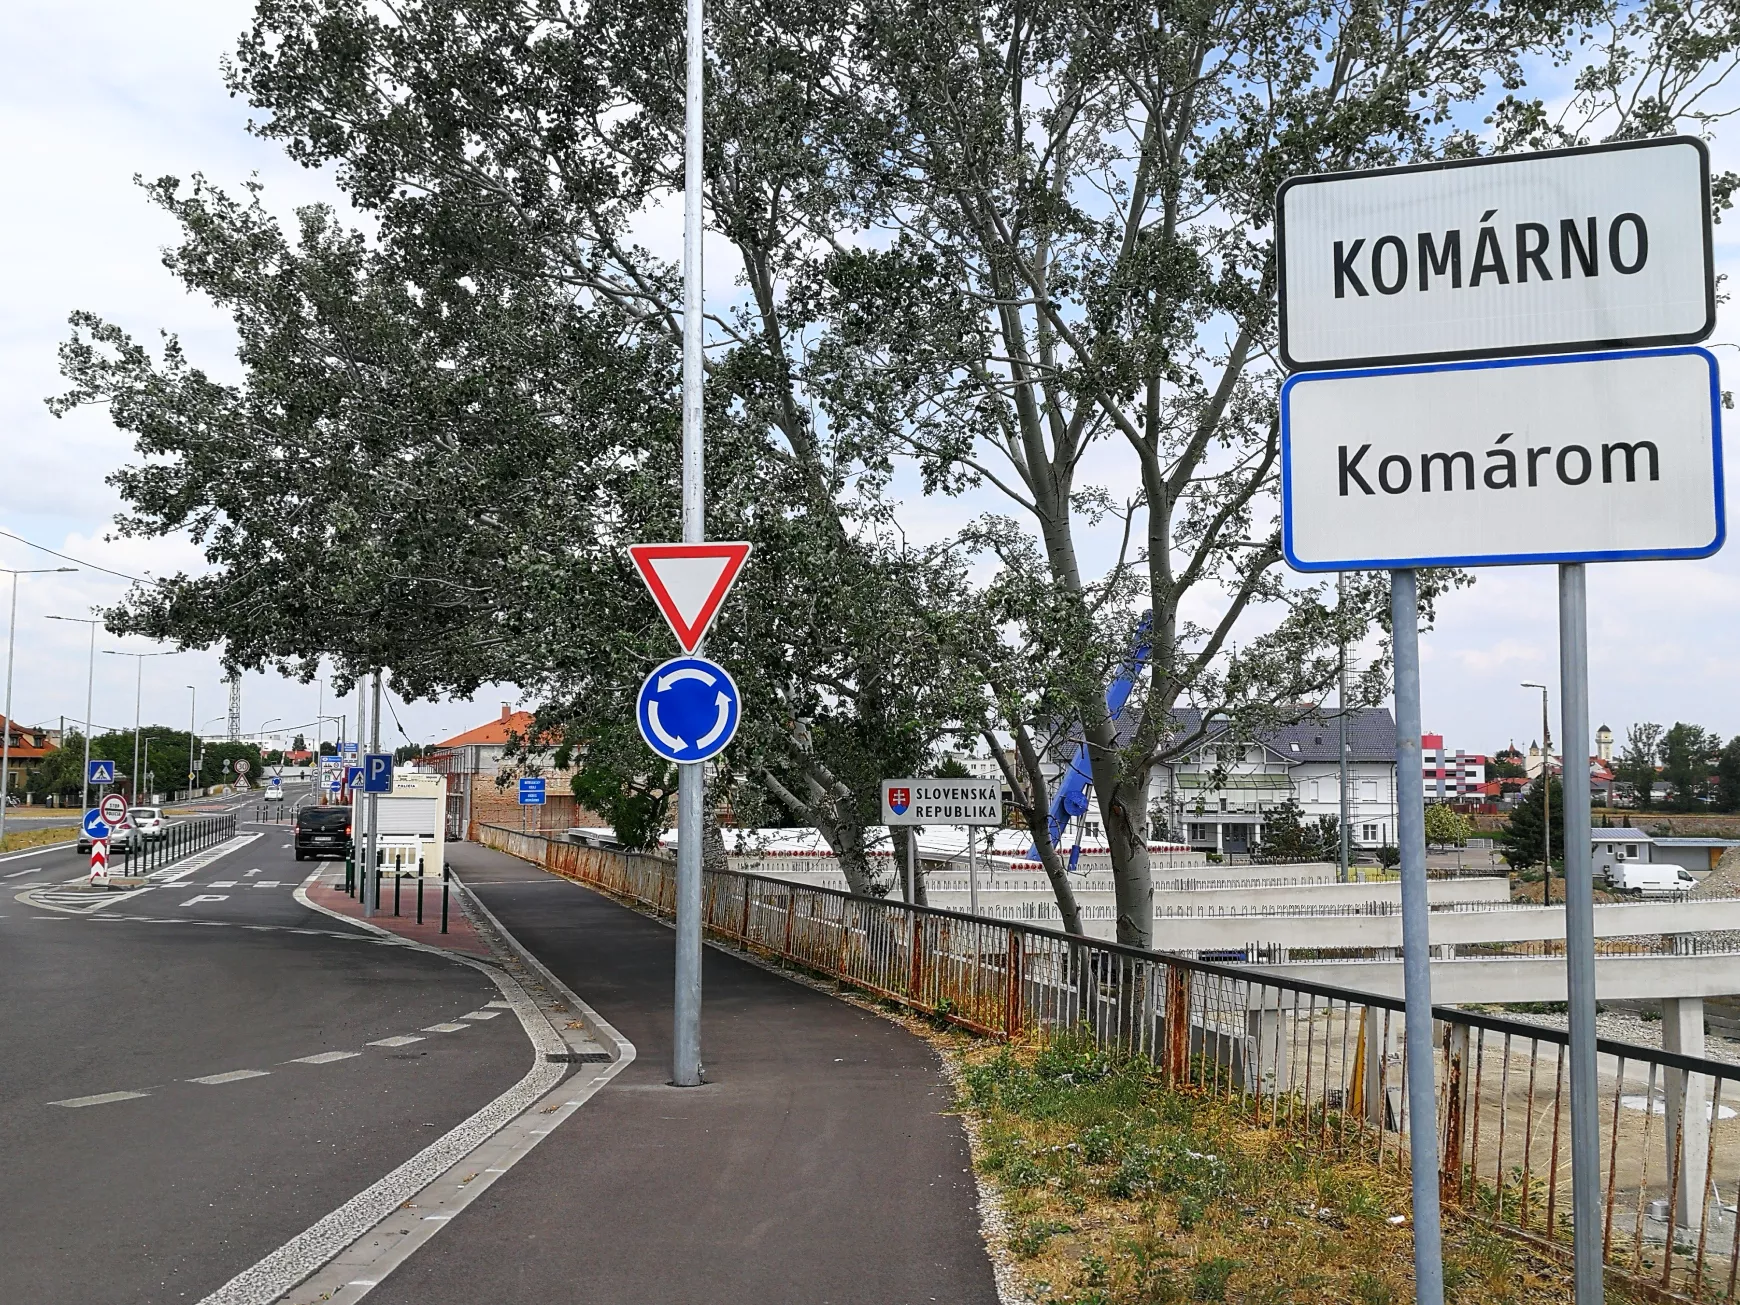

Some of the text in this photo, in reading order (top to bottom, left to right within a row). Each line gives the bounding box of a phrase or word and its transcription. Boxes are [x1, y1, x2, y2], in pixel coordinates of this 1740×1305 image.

[1333, 209, 1648, 298] KOMÁRNO
[1338, 433, 1659, 496] Komárom
[371, 758, 385, 780] P
[916, 785, 996, 800] SLOVENSKÁ
[916, 806, 996, 817] REPUBLIKA
